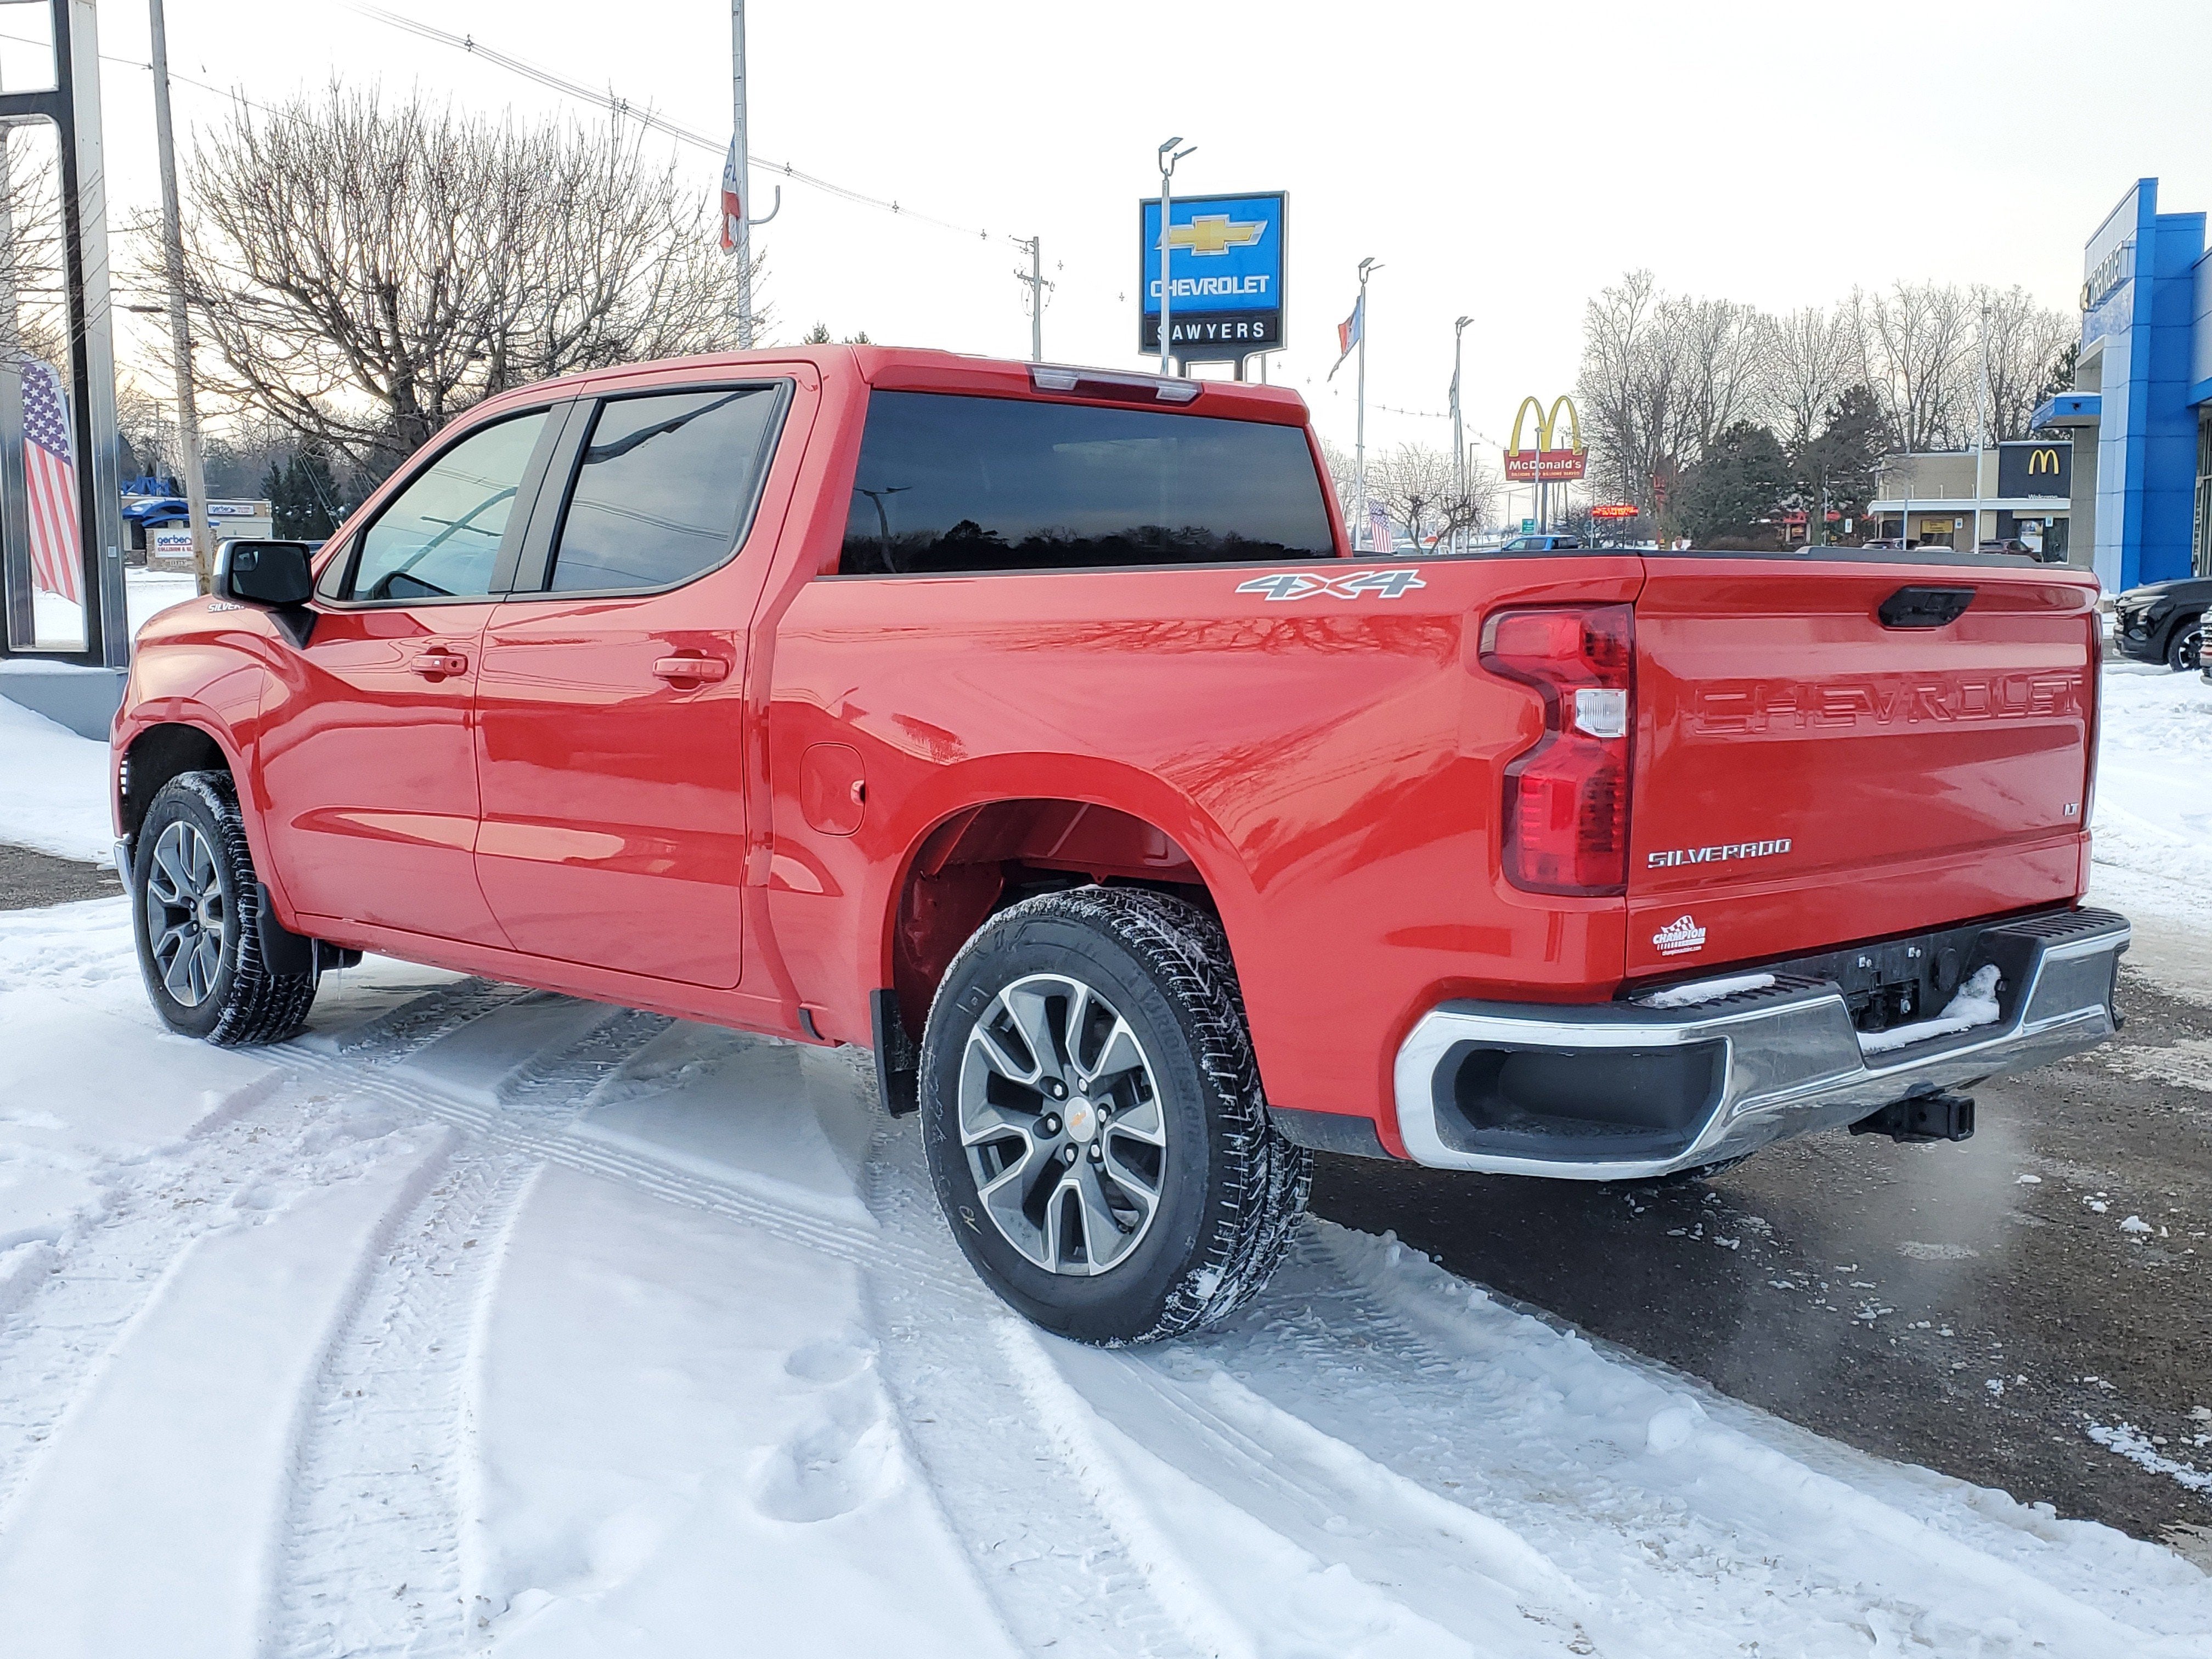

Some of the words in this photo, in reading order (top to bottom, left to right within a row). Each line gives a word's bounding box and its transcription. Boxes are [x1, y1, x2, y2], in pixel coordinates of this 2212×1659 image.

[1150, 275, 1269, 297] CHEVROLET
[1509, 459, 1582, 470] McDonald's
[157, 534, 190, 546] gerber
[1694, 674, 2083, 734] CHEVROLET
[1647, 838, 1792, 868] SILVERADO
[1653, 927, 1706, 944] CHAMPION
